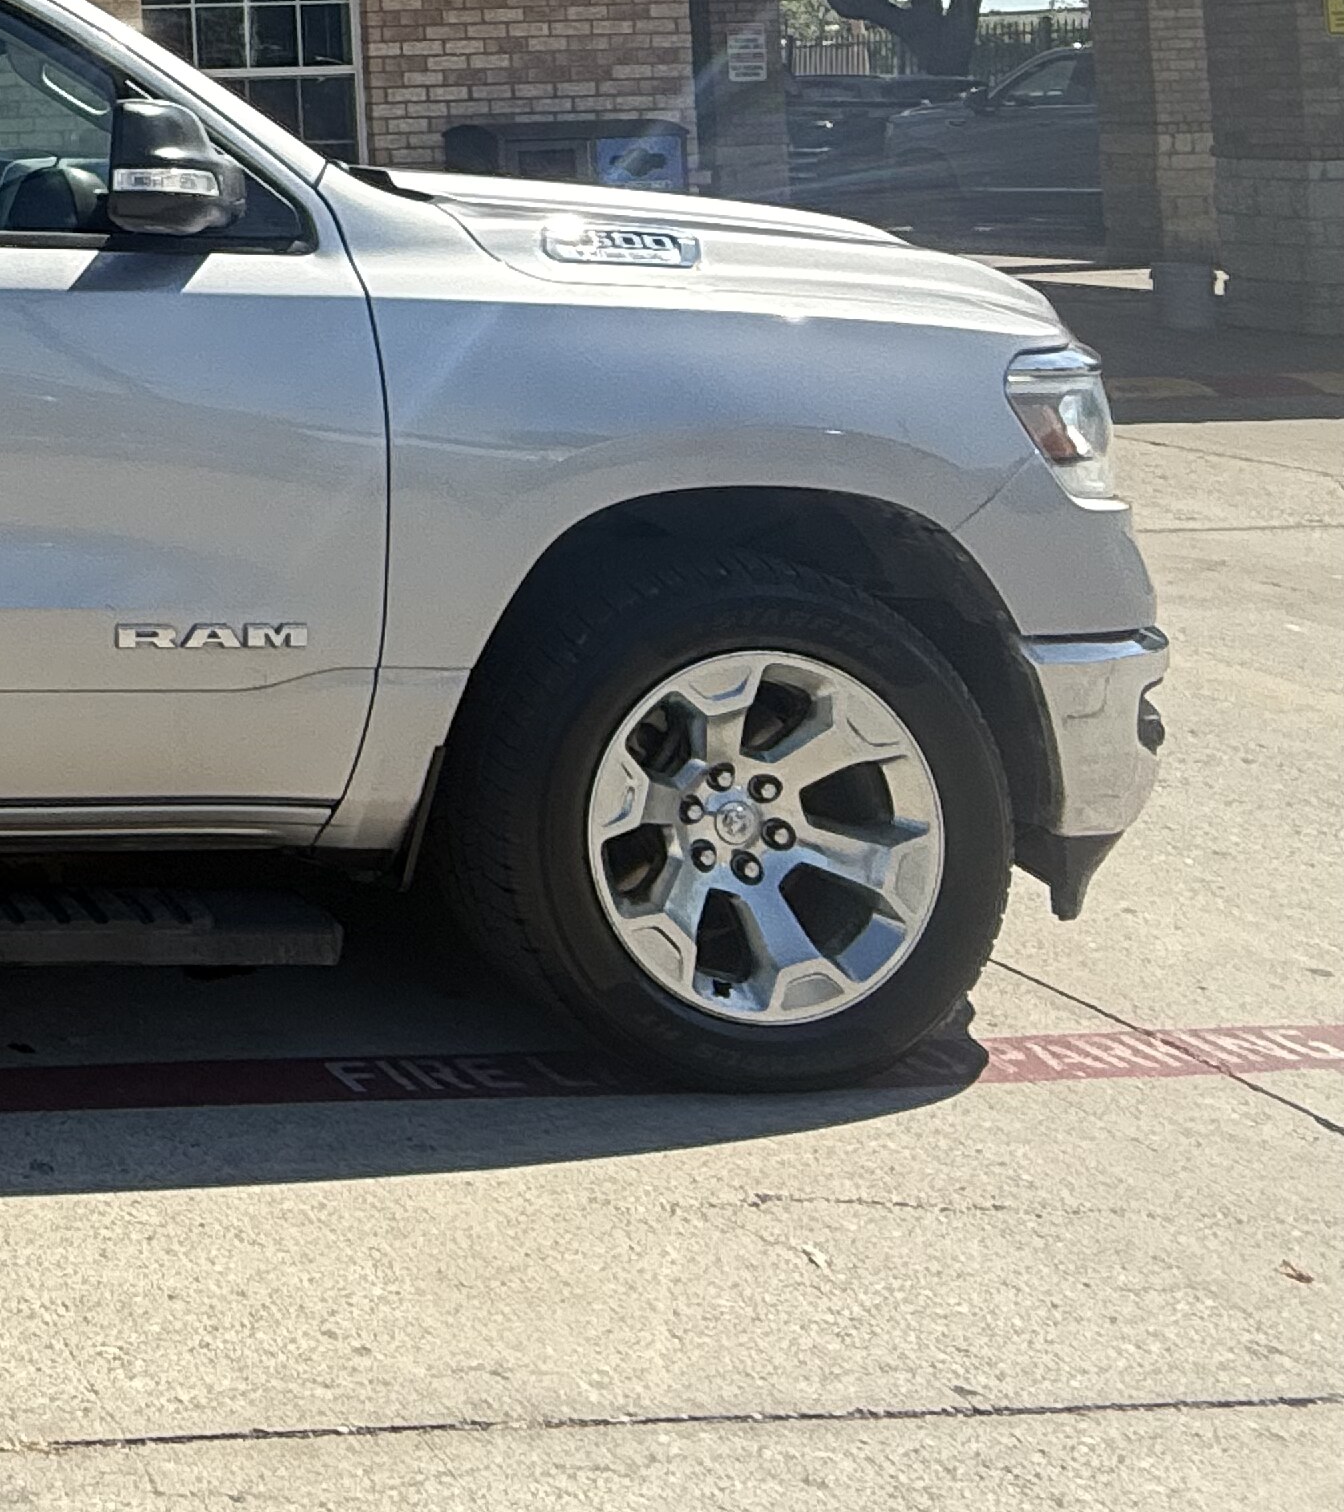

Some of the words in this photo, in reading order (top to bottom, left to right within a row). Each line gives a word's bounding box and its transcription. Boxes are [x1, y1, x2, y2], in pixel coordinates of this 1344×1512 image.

[115, 622, 308, 649] RAM
[980, 1027, 1343, 1075] PARKING
[323, 1056, 528, 1093] FIRE
